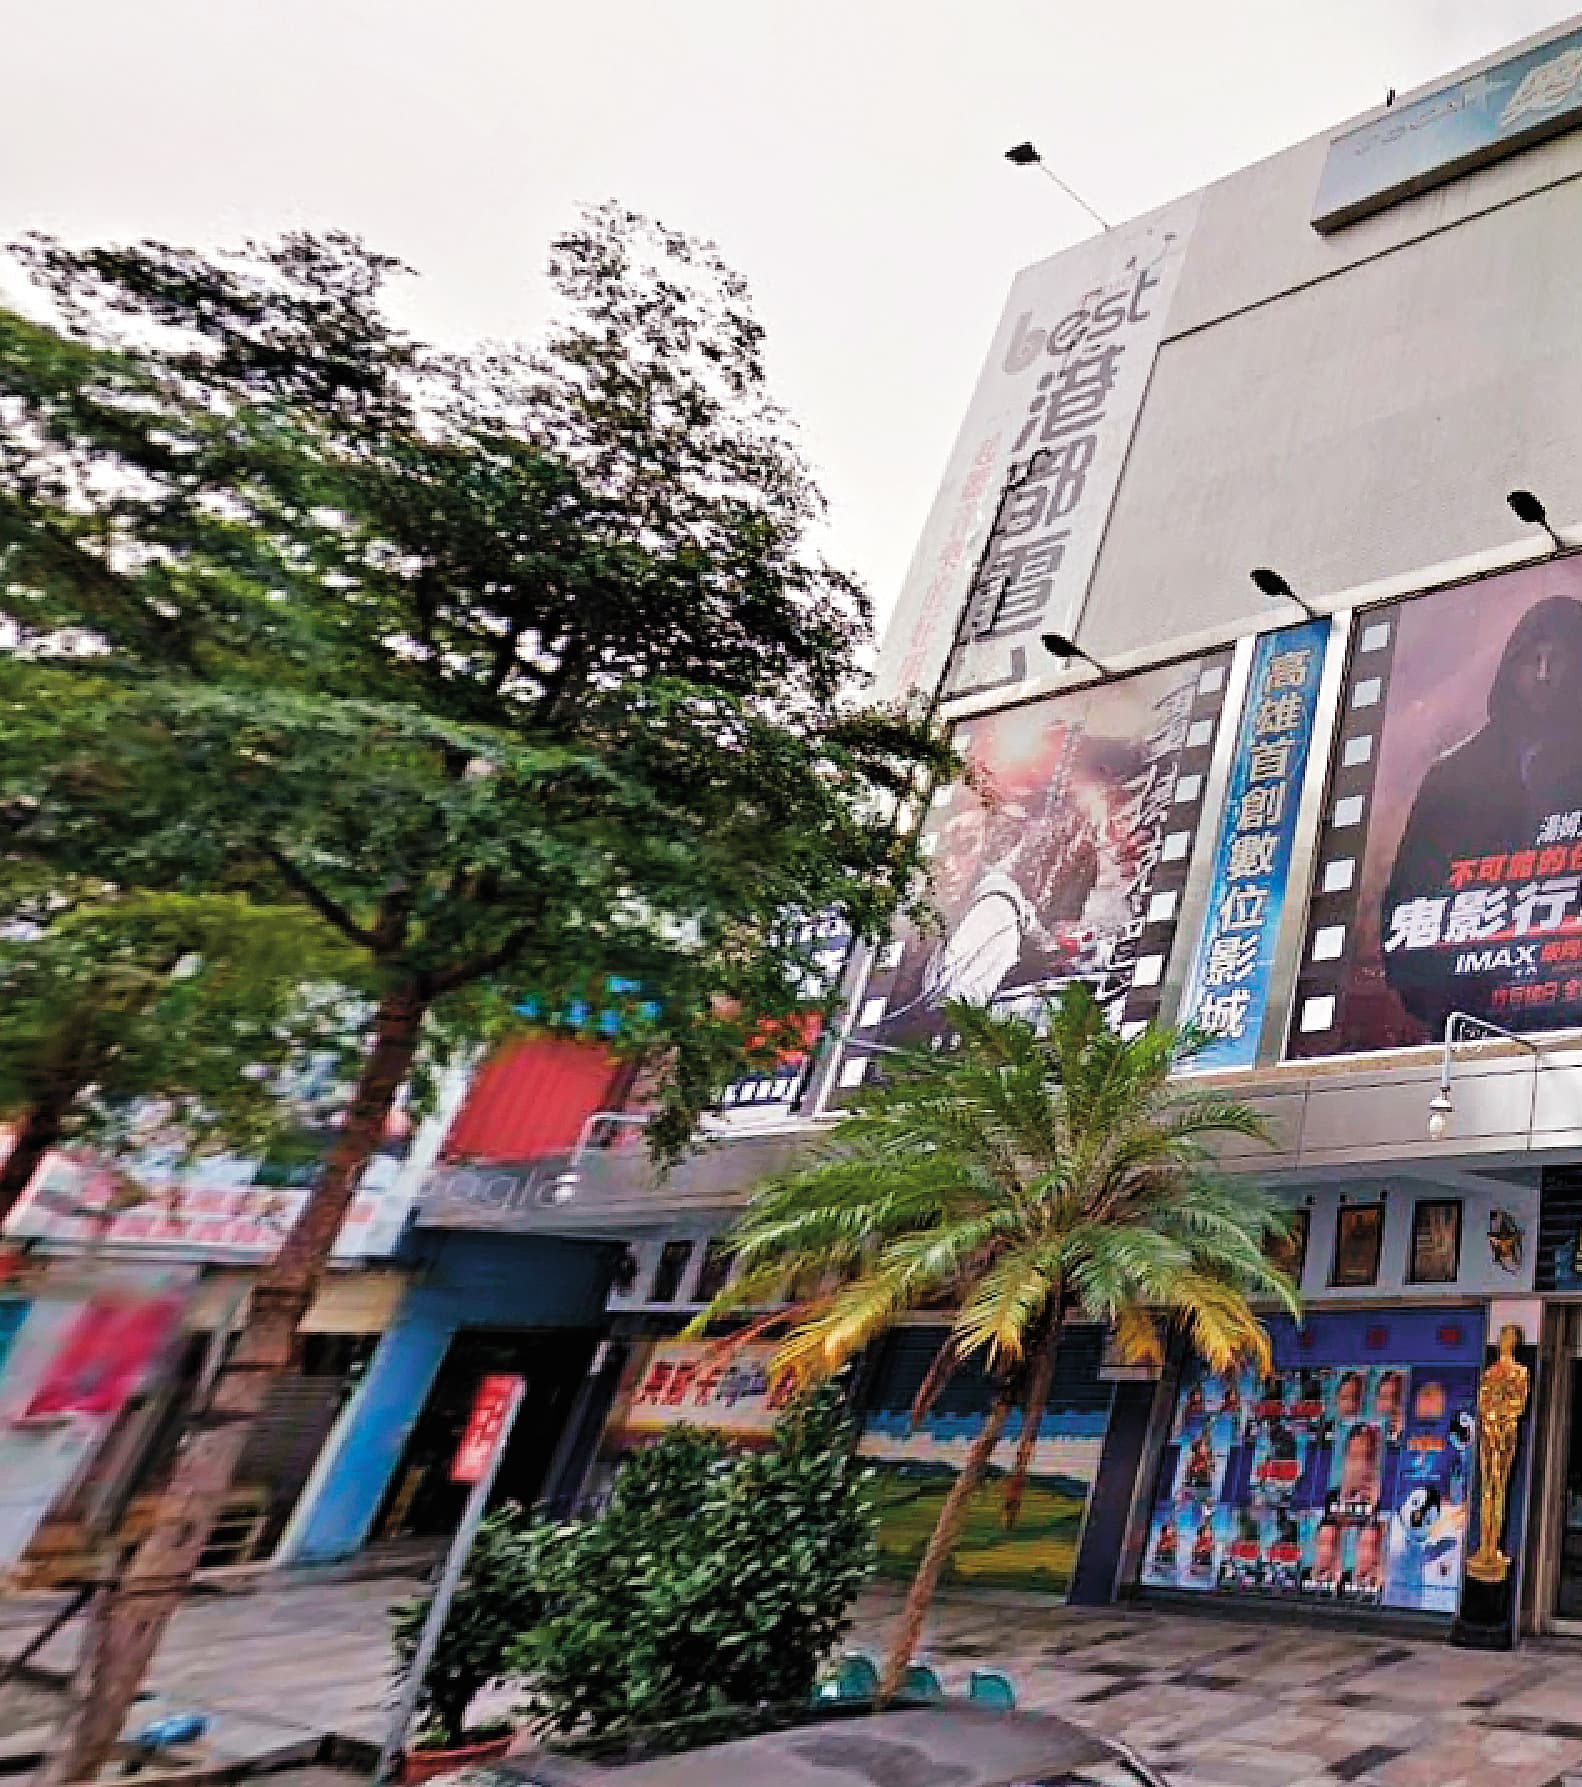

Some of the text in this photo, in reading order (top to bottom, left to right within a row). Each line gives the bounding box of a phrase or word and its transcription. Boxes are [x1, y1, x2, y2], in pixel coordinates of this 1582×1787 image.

[1197, 649, 1310, 1040] 高雄首創數位影城
[1454, 944, 1539, 976] IMAX
